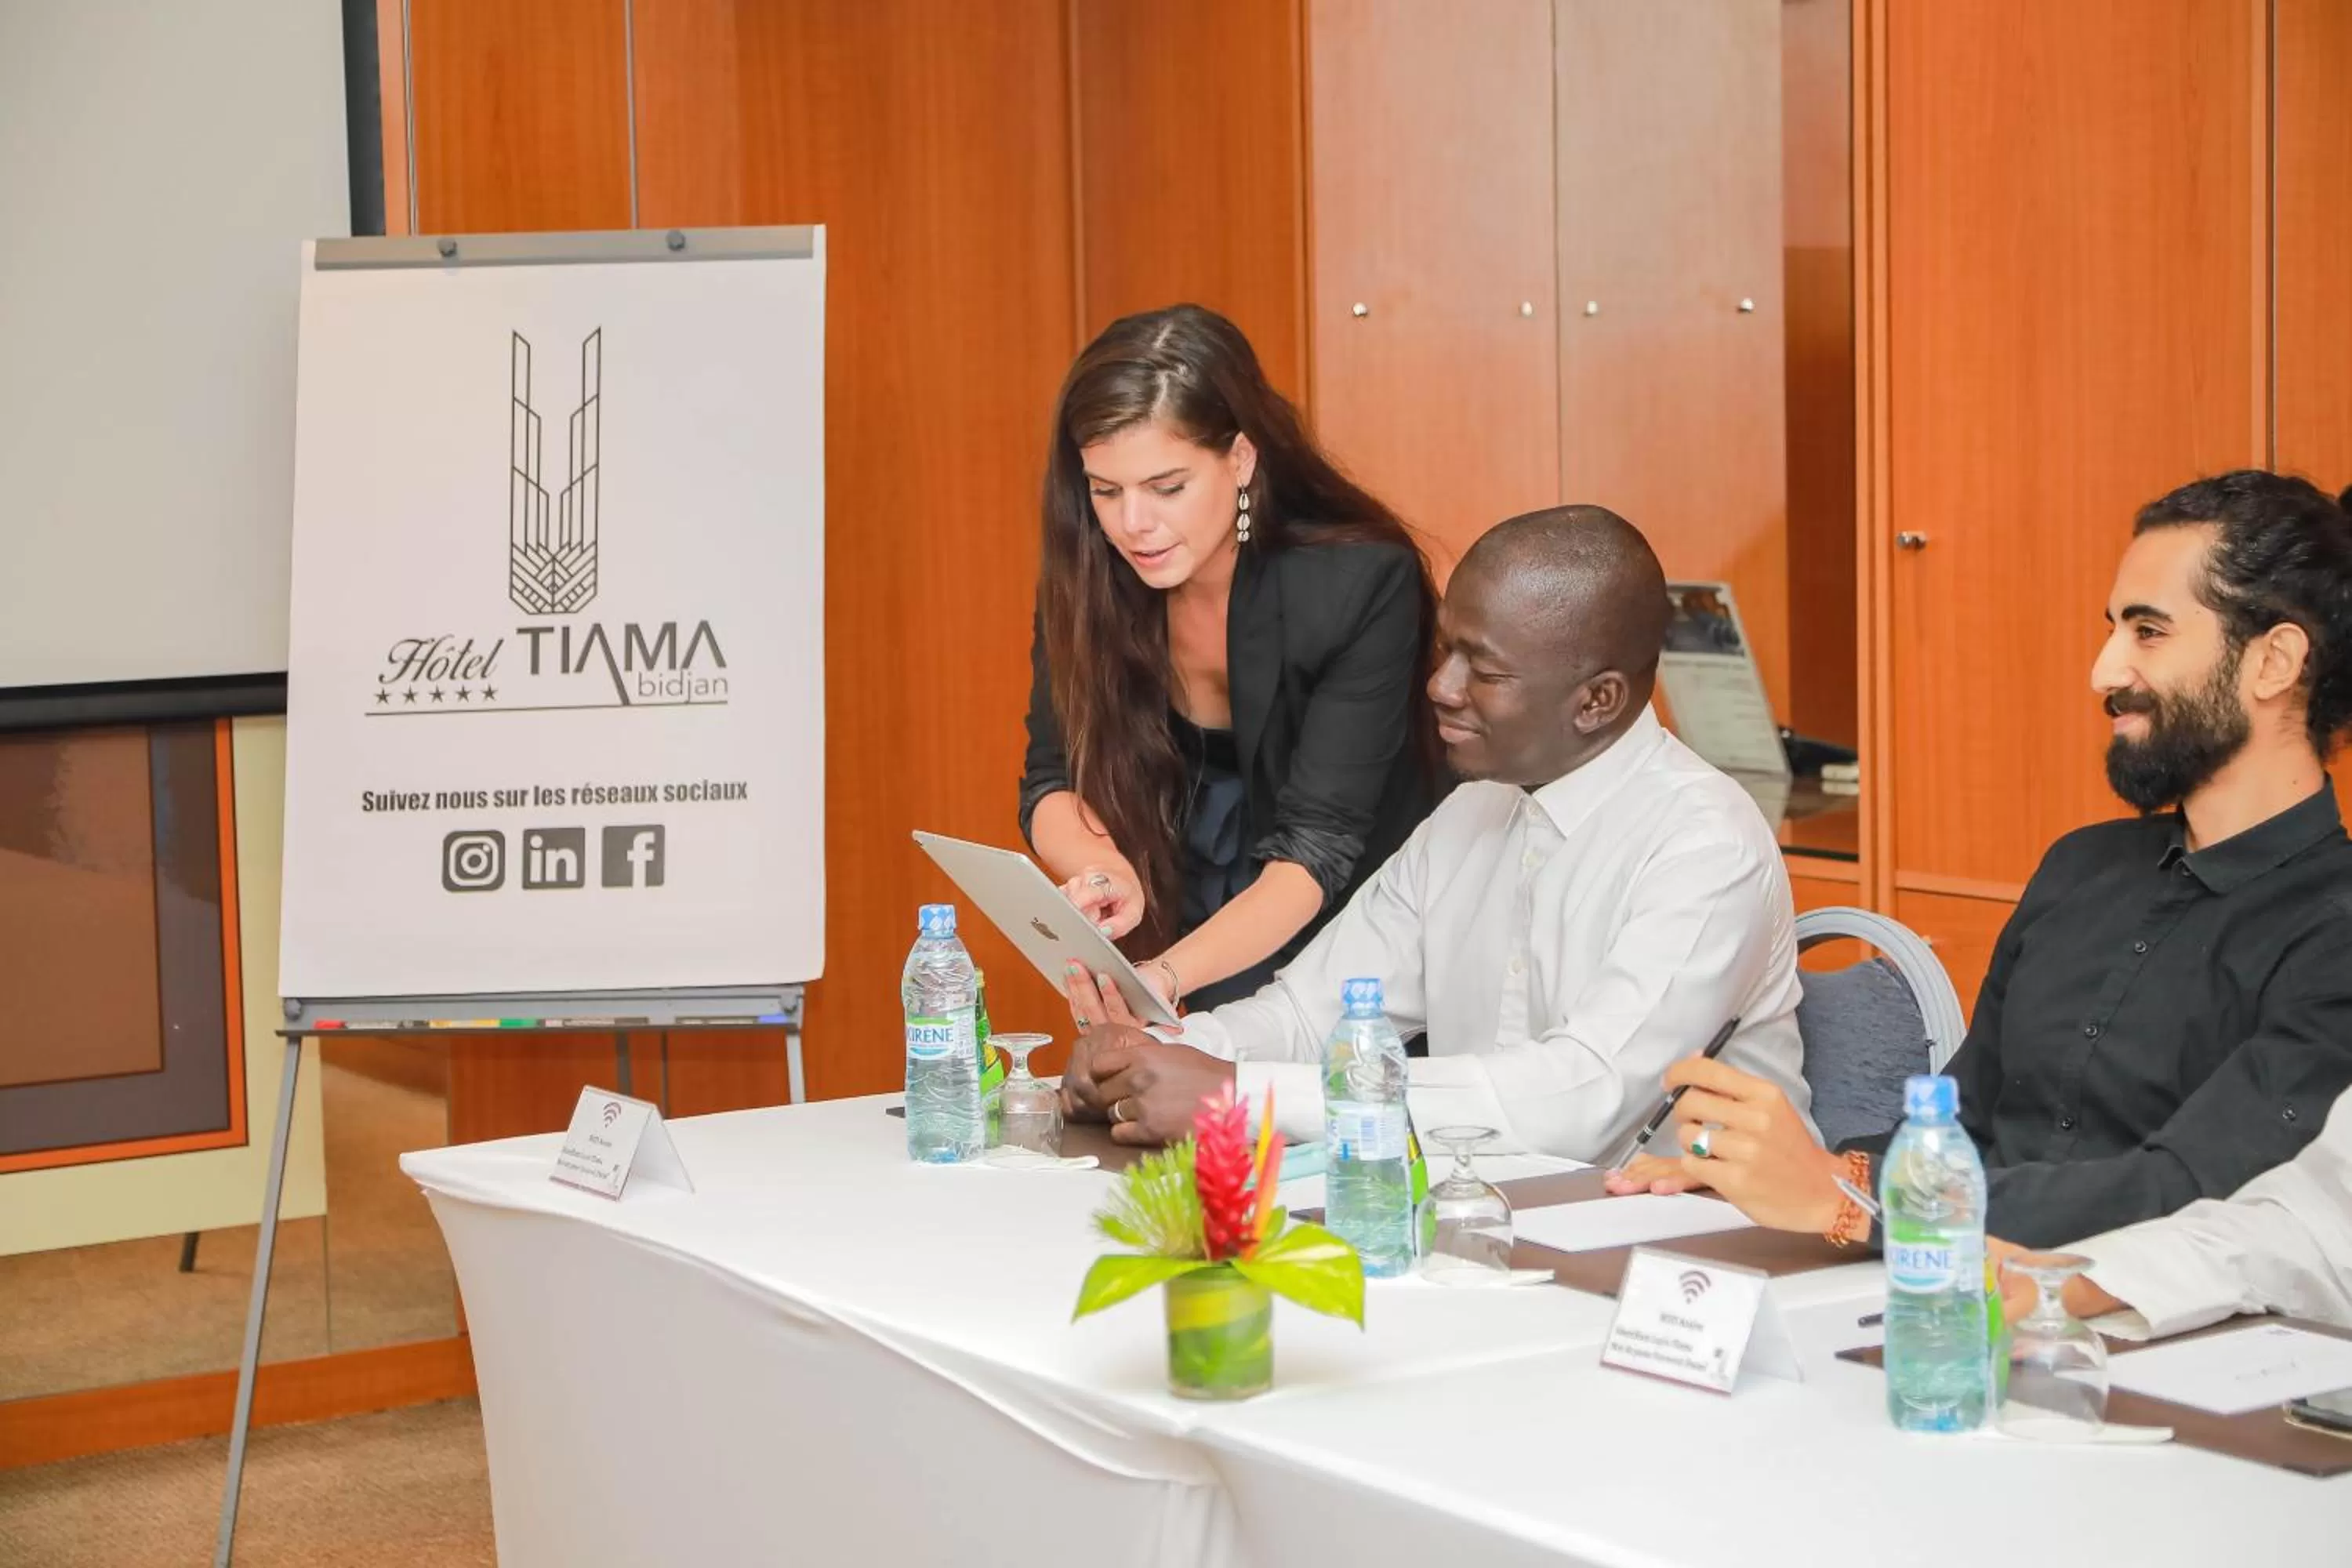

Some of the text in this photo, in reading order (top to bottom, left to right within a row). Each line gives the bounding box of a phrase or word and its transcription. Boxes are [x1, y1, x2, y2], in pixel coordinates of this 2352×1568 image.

[378, 619, 728, 706] Hôtel TIAMA
[637, 671, 728, 703] bidjan
[361, 779, 748, 812] Suivez nous sur les réseaux sociaux
[529, 834, 579, 884] in
